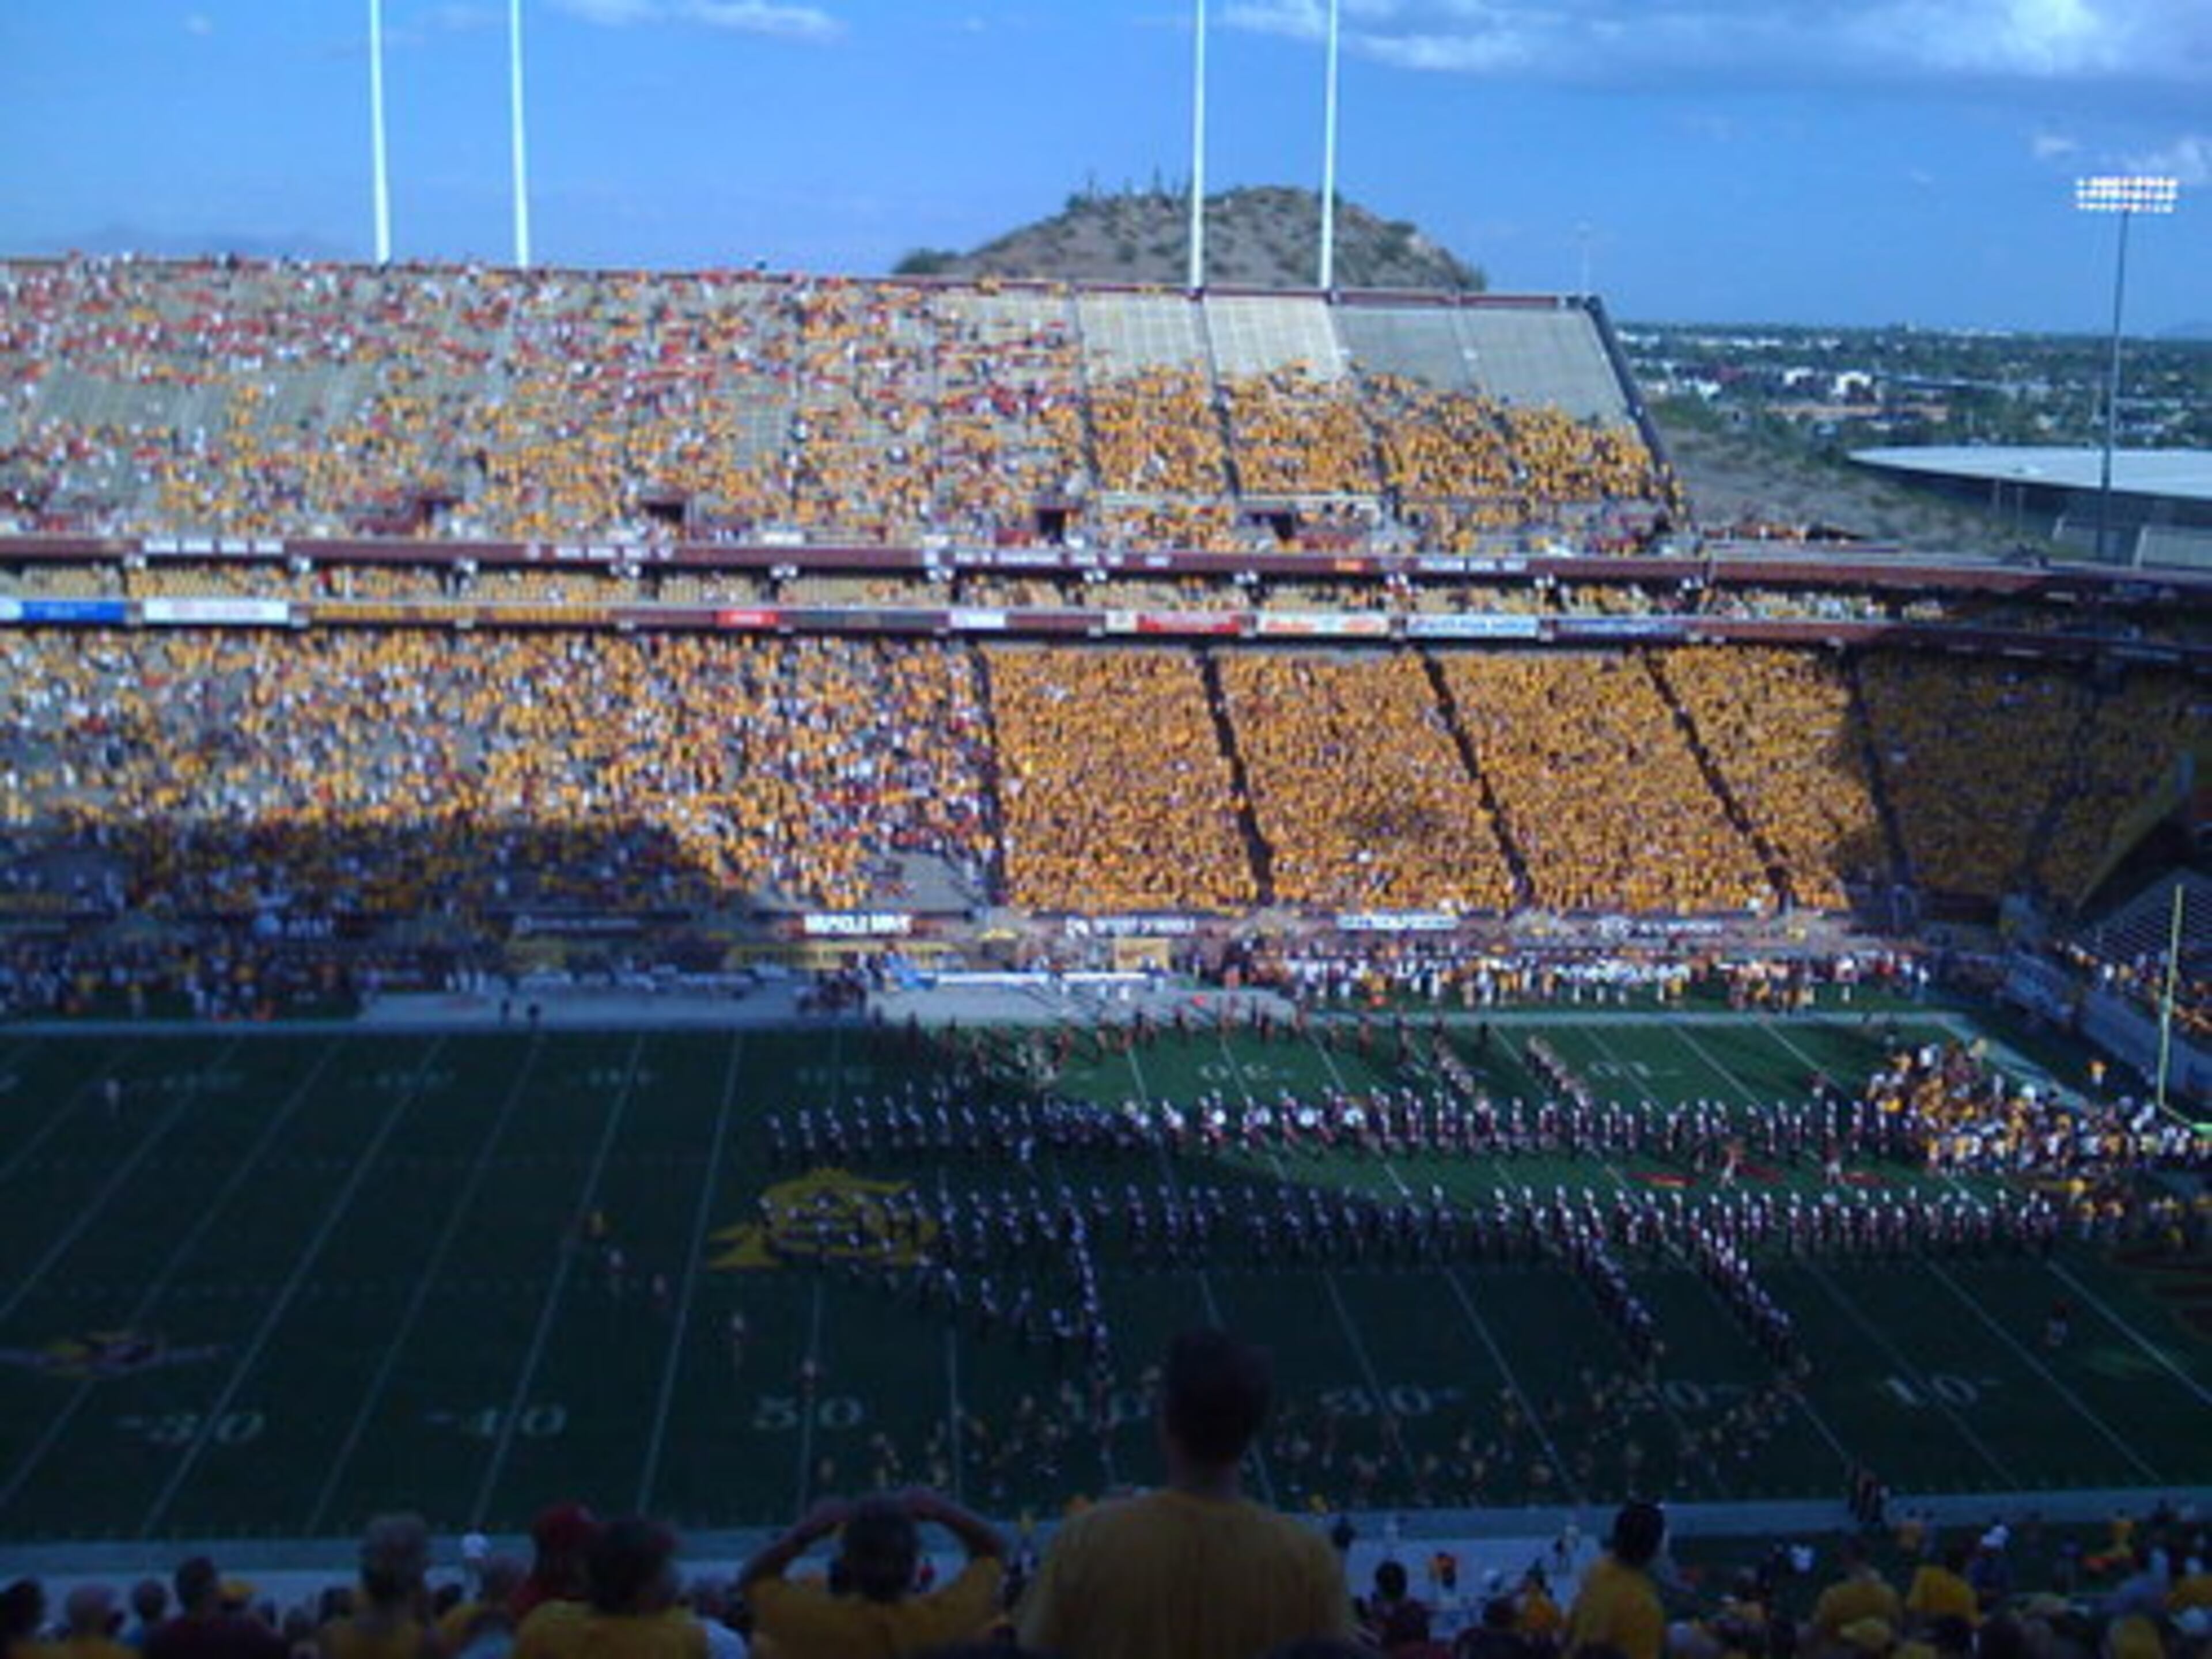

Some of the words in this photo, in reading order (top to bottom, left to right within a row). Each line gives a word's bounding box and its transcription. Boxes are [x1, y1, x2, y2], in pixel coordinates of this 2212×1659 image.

[1884, 1374, 1979, 1404] 10
[146, 1411, 266, 1444] 30
[461, 1404, 567, 1437] 40
[752, 1396, 863, 1431] 50
